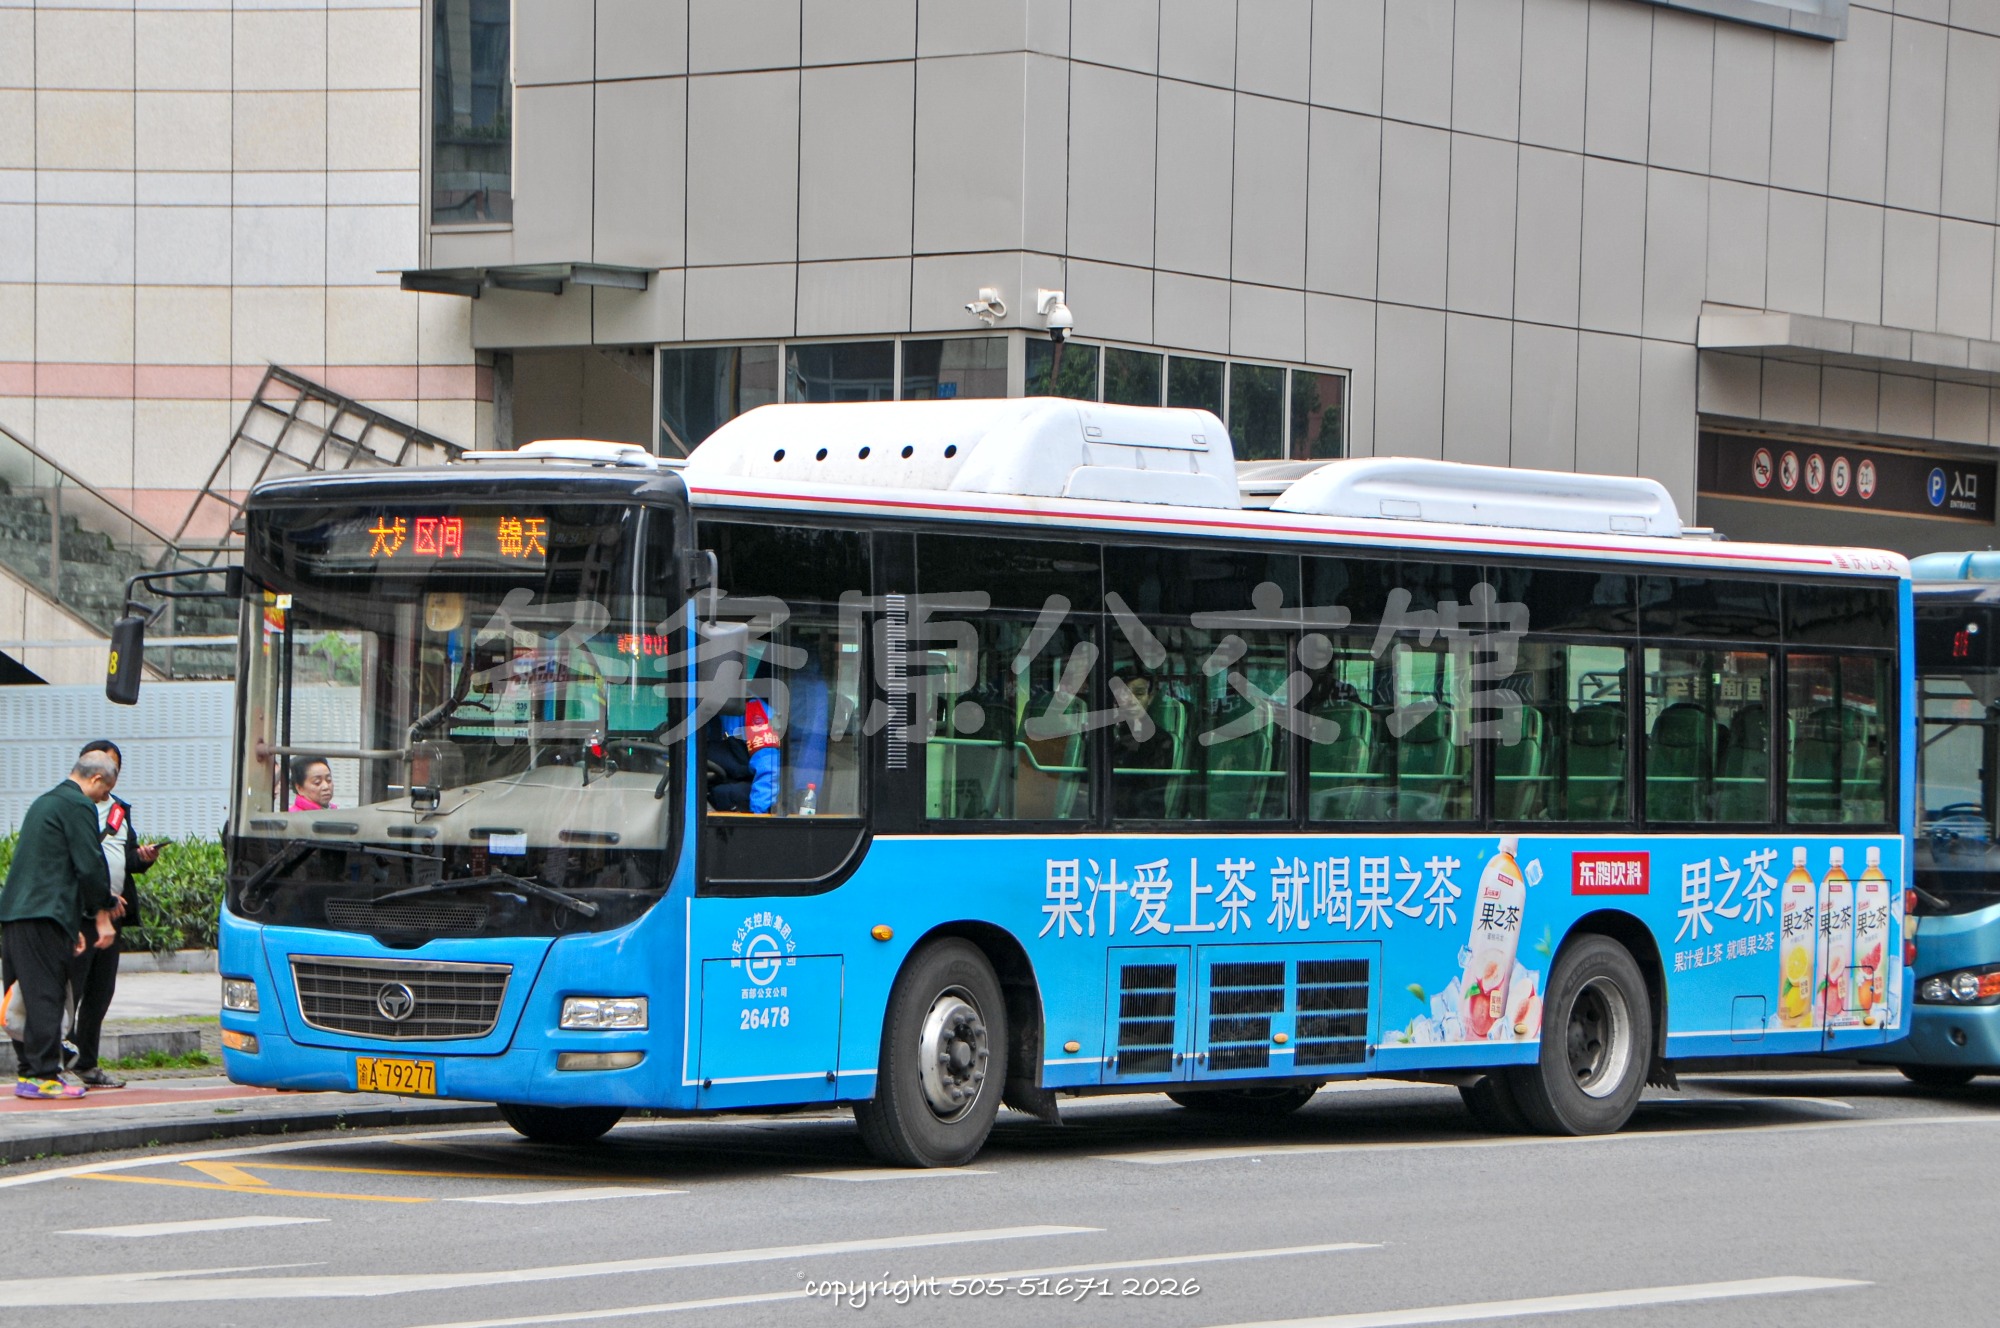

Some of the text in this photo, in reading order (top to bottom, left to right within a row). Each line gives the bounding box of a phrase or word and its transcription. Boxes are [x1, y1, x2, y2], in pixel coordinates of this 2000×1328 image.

[1836, 466, 1845, 489] 5
[1950, 471, 1977, 498] 入口
[1950, 500, 1976, 511] ENTRANCE
[415, 516, 463, 558] 区间
[497, 516, 547, 558] 锦天
[1831, 552, 1898, 571] 重庆公交
[1579, 861, 1643, 886] 东鹏饮料
[1038, 855, 1462, 938] 果汁爱上茶 就喝果之茶
[1674, 847, 1779, 944] 果之茶
[1477, 902, 1520, 931] 果之茶
[1782, 906, 1814, 939] 果之茶
[1819, 906, 1851, 939] 果之茶
[1856, 905, 1887, 938] 果之茶
[1674, 931, 1775, 973] 果汁爱上茶 就喝果之茶
[741, 987, 788, 999] 西部公交公司
[740, 1006, 790, 1030] 26478
